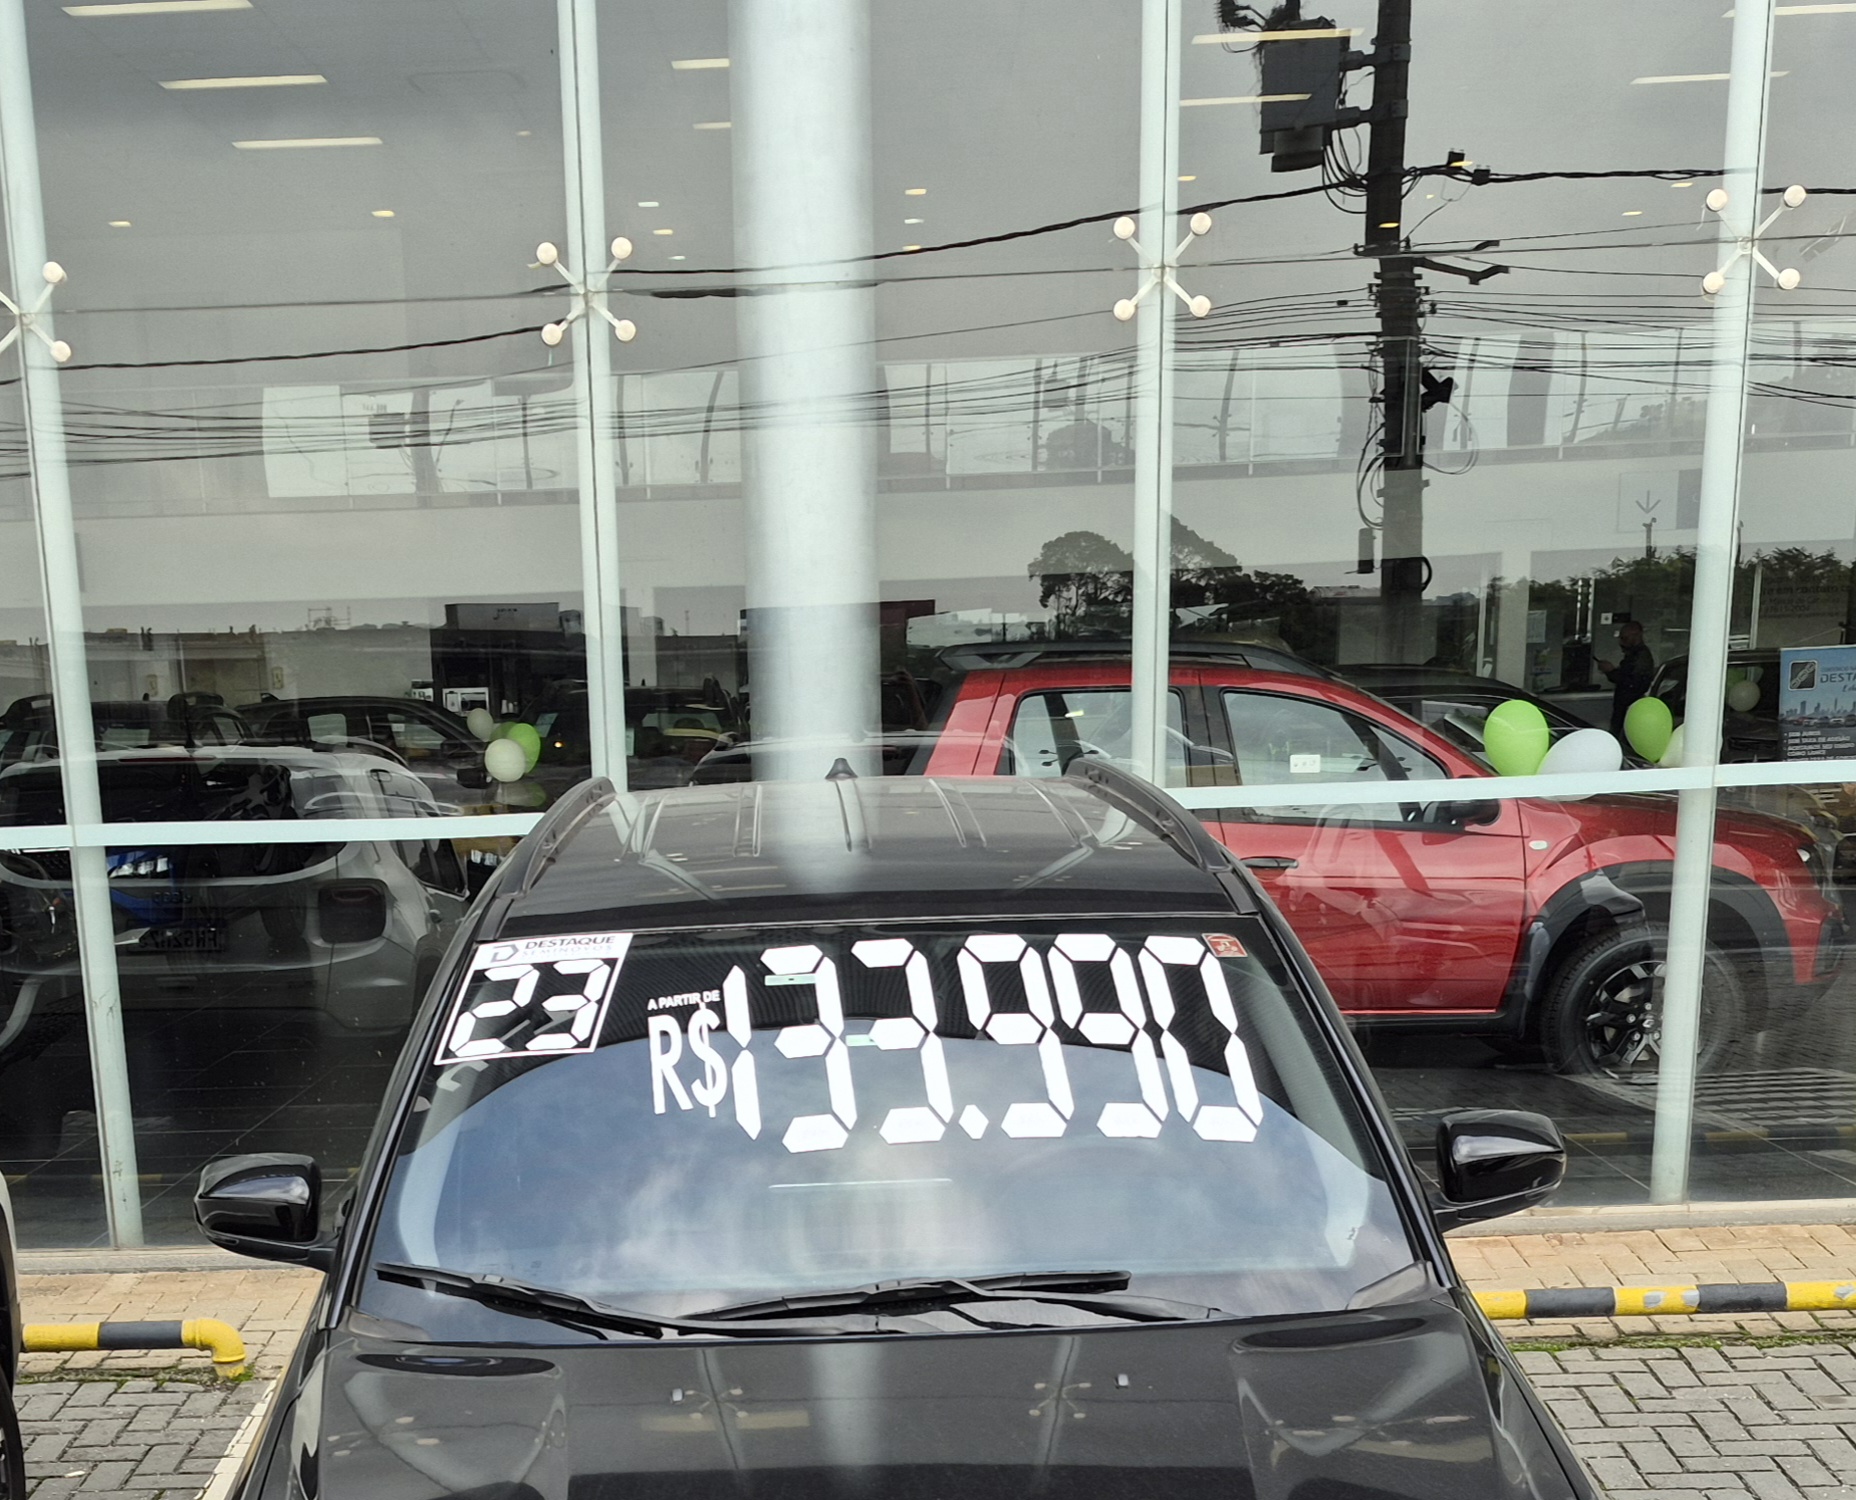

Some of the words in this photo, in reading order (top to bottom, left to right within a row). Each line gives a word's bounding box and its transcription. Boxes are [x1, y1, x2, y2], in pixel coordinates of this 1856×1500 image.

[524, 935, 617, 951] DESTAQUE
[448, 957, 612, 1058] 23
[647, 998, 659, 1011] A
[658, 992, 702, 1009] PARTIR
[702, 989, 721, 1003] DE
